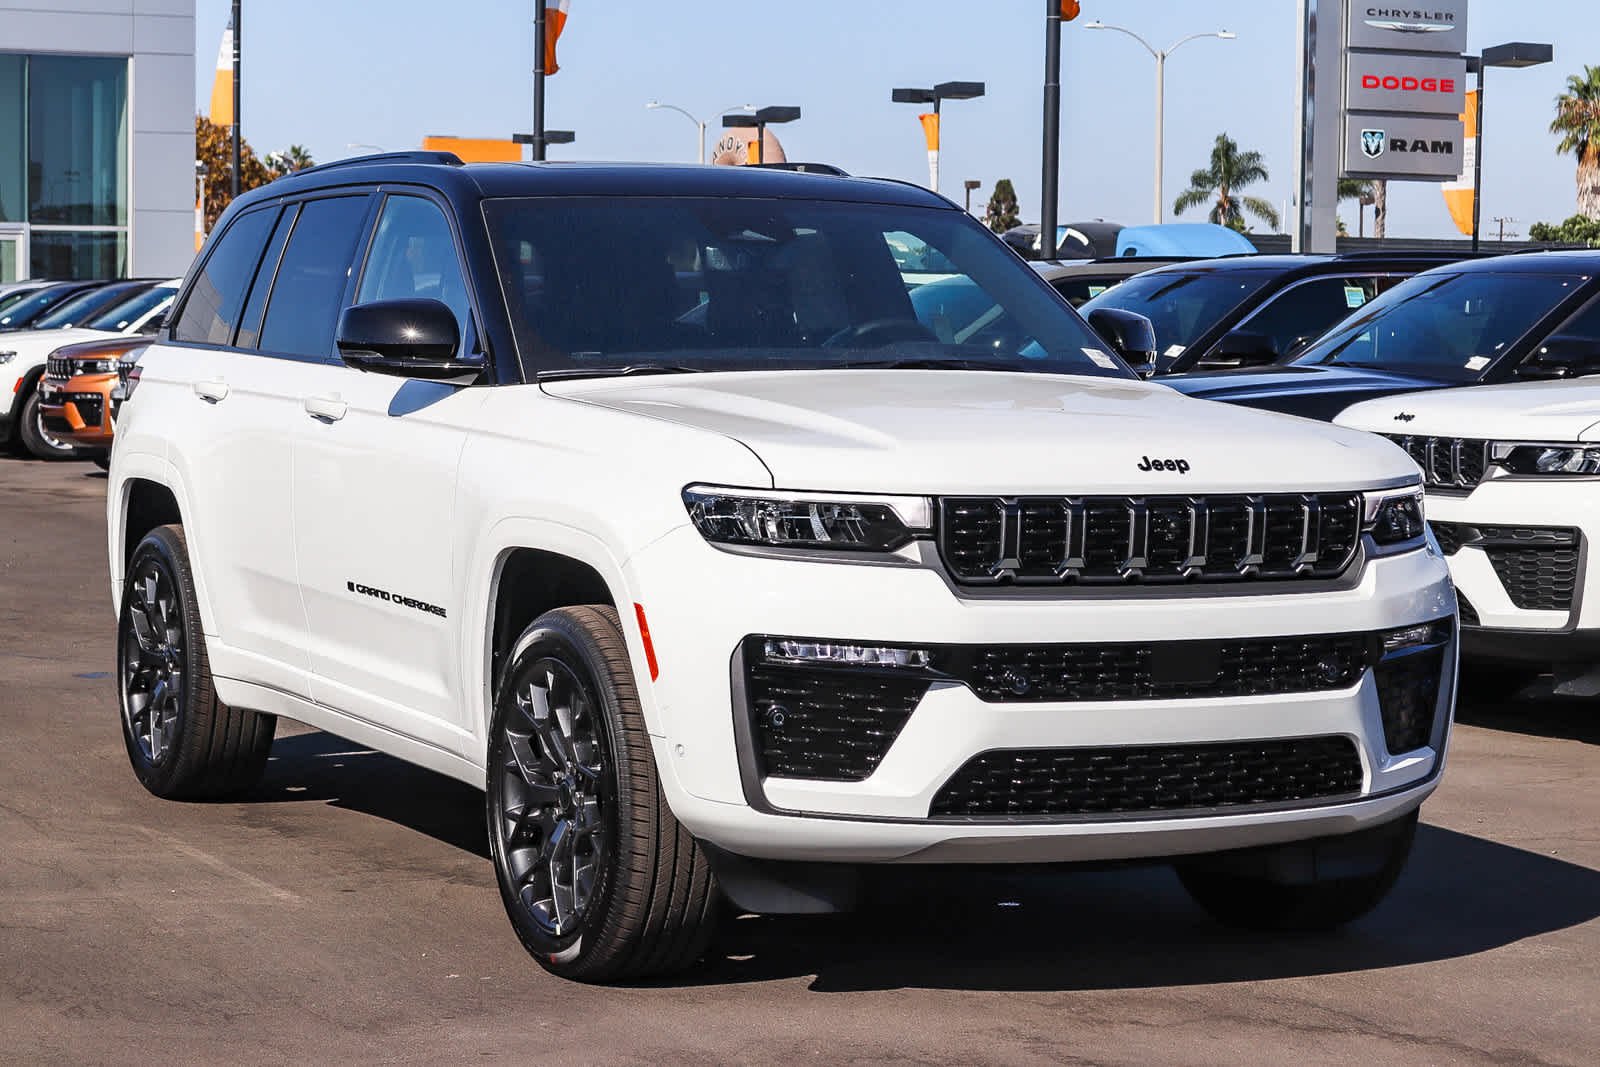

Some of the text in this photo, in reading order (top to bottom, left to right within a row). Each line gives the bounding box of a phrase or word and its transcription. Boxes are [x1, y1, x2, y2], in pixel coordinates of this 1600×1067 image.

[1366, 8, 1455, 21] CHRYSLER
[1361, 75, 1455, 93] DODGE
[1389, 138, 1453, 154] RAM
[1137, 455, 1191, 475] Jeep
[355, 583, 448, 619] GRAND CHEROKEE
